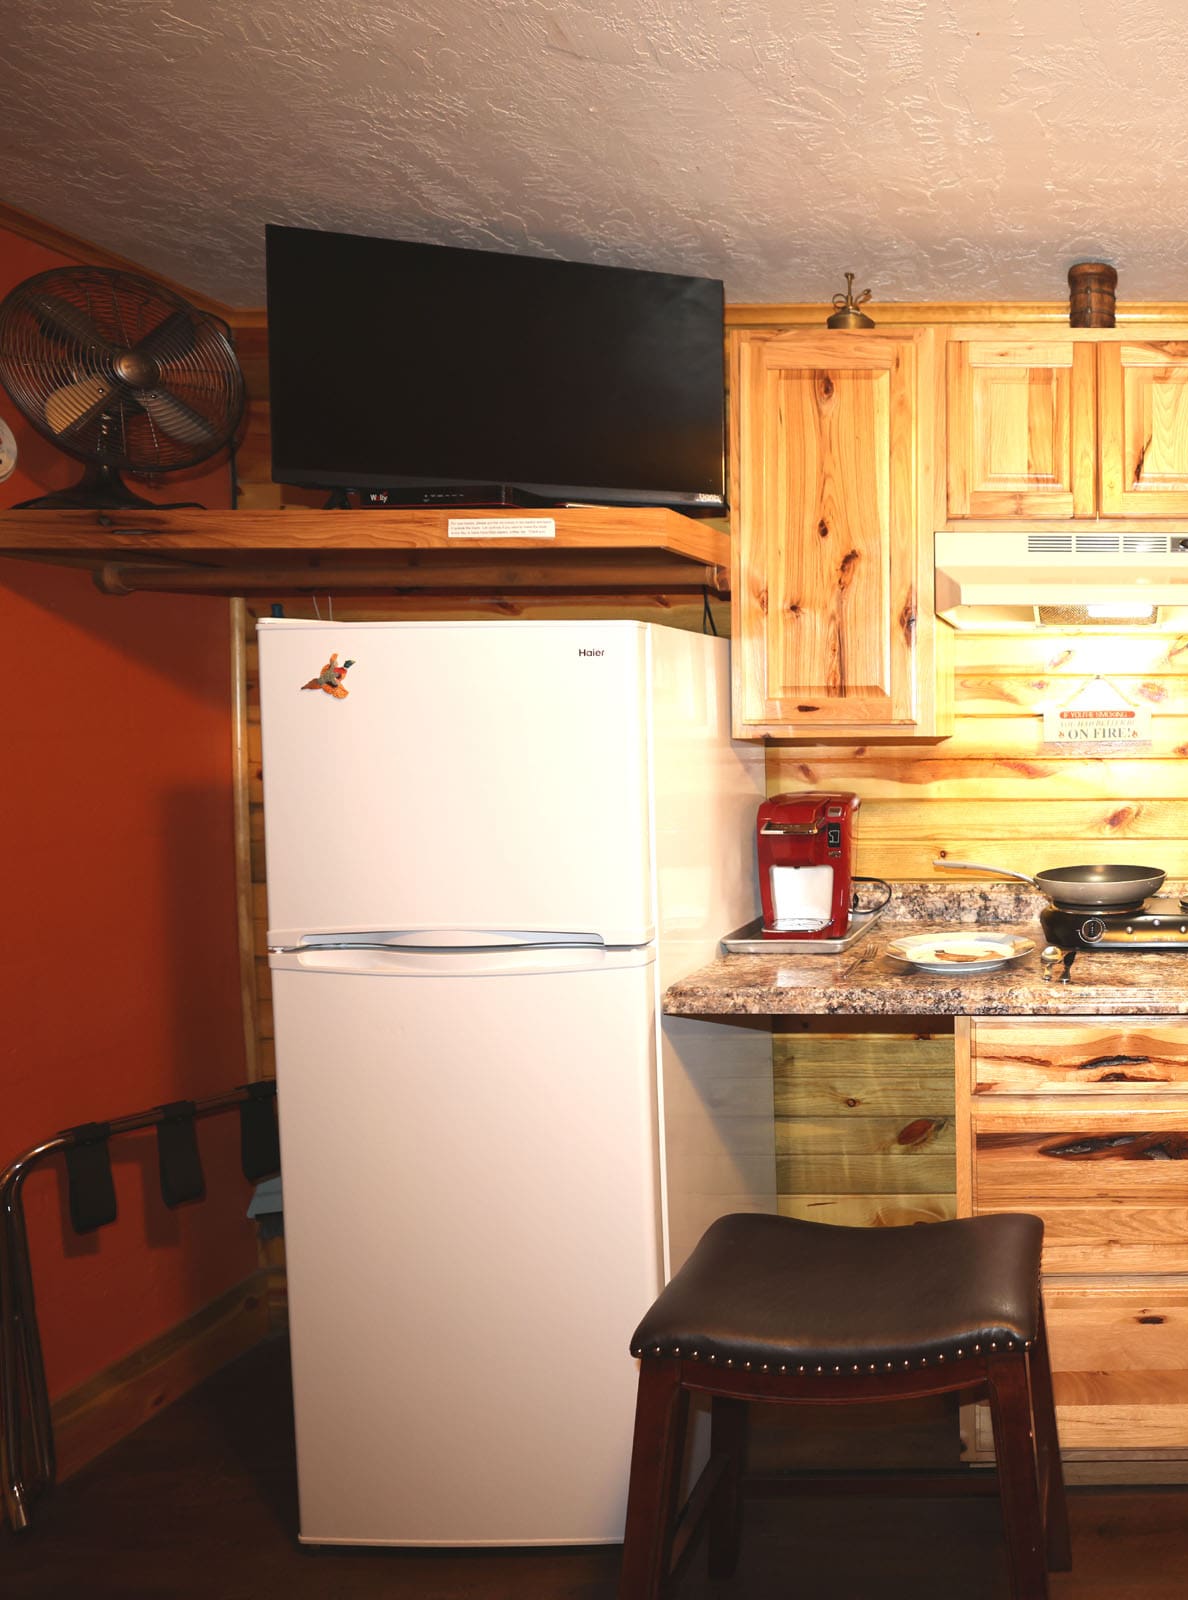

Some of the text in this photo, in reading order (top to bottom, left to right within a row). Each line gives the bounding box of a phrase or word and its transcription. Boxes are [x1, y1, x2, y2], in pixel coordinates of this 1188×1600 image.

[578, 648, 605, 657] Haier
[1068, 727, 1131, 740] ON FIRE!
